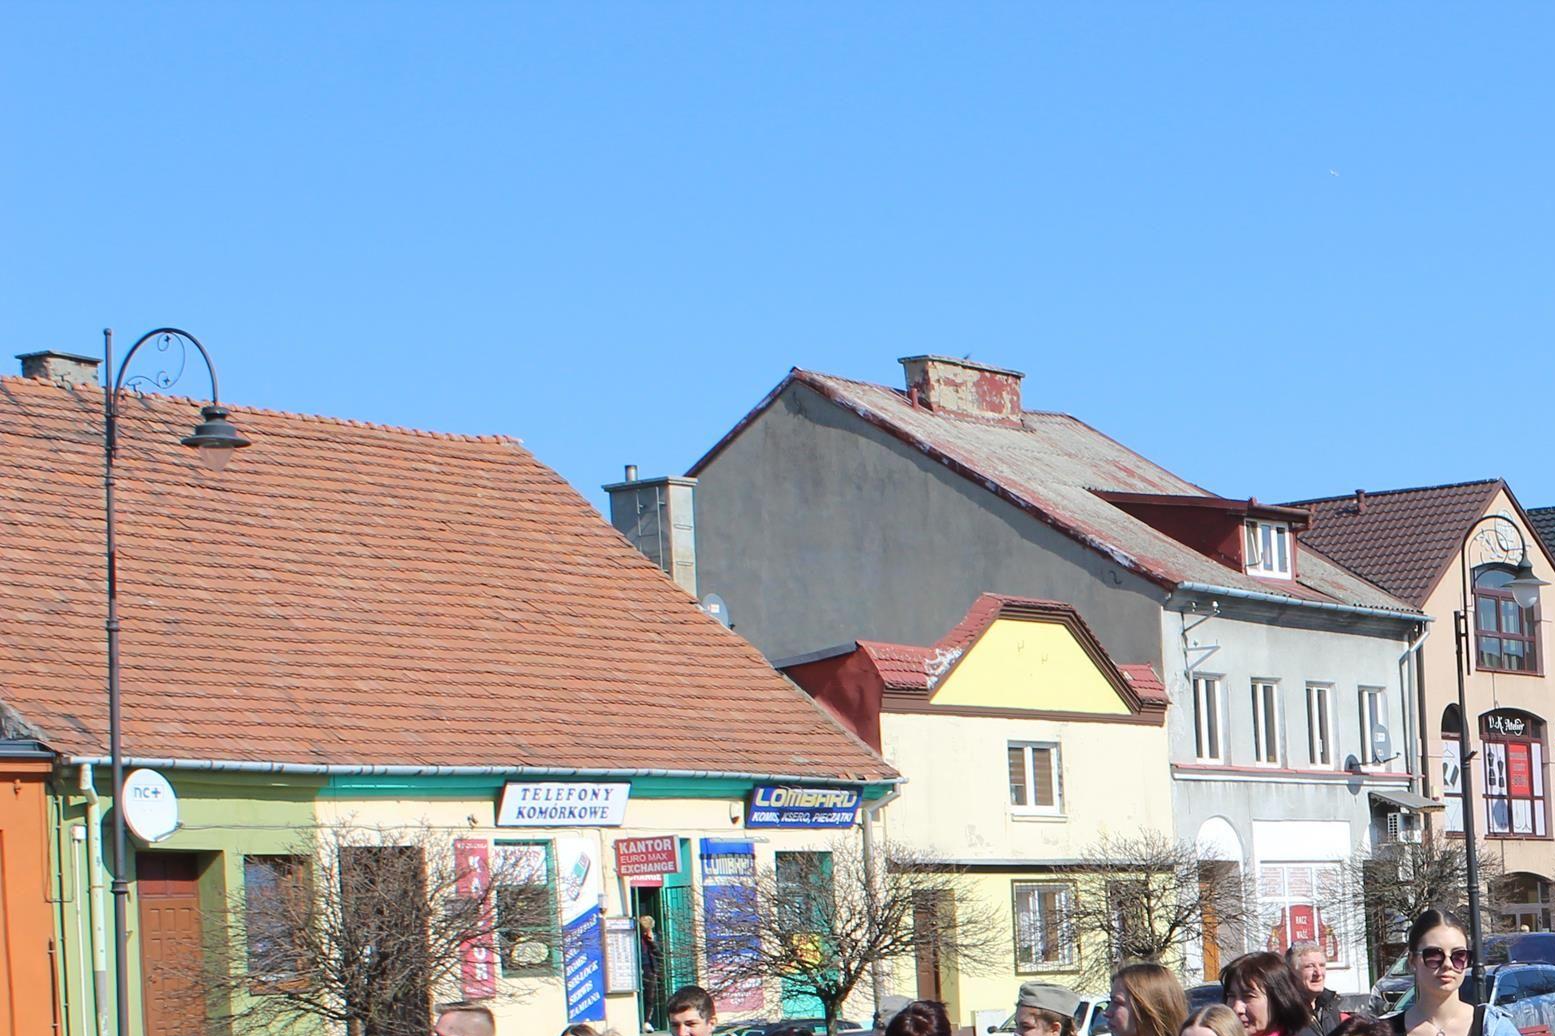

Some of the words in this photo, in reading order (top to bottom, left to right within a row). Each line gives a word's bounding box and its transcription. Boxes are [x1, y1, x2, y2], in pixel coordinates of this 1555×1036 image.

[134, 787, 161, 798] nc+
[521, 788, 613, 800] TELEFONY
[756, 788, 857, 807] LOMBARD
[516, 803, 609, 819] KOMÓRKOWE
[781, 812, 810, 823] KSERO,
[619, 839, 672, 854] KANTOR
[621, 853, 646, 863] EURO
[648, 852, 668, 860] MAX
[621, 861, 675, 873] EXCHANGE
